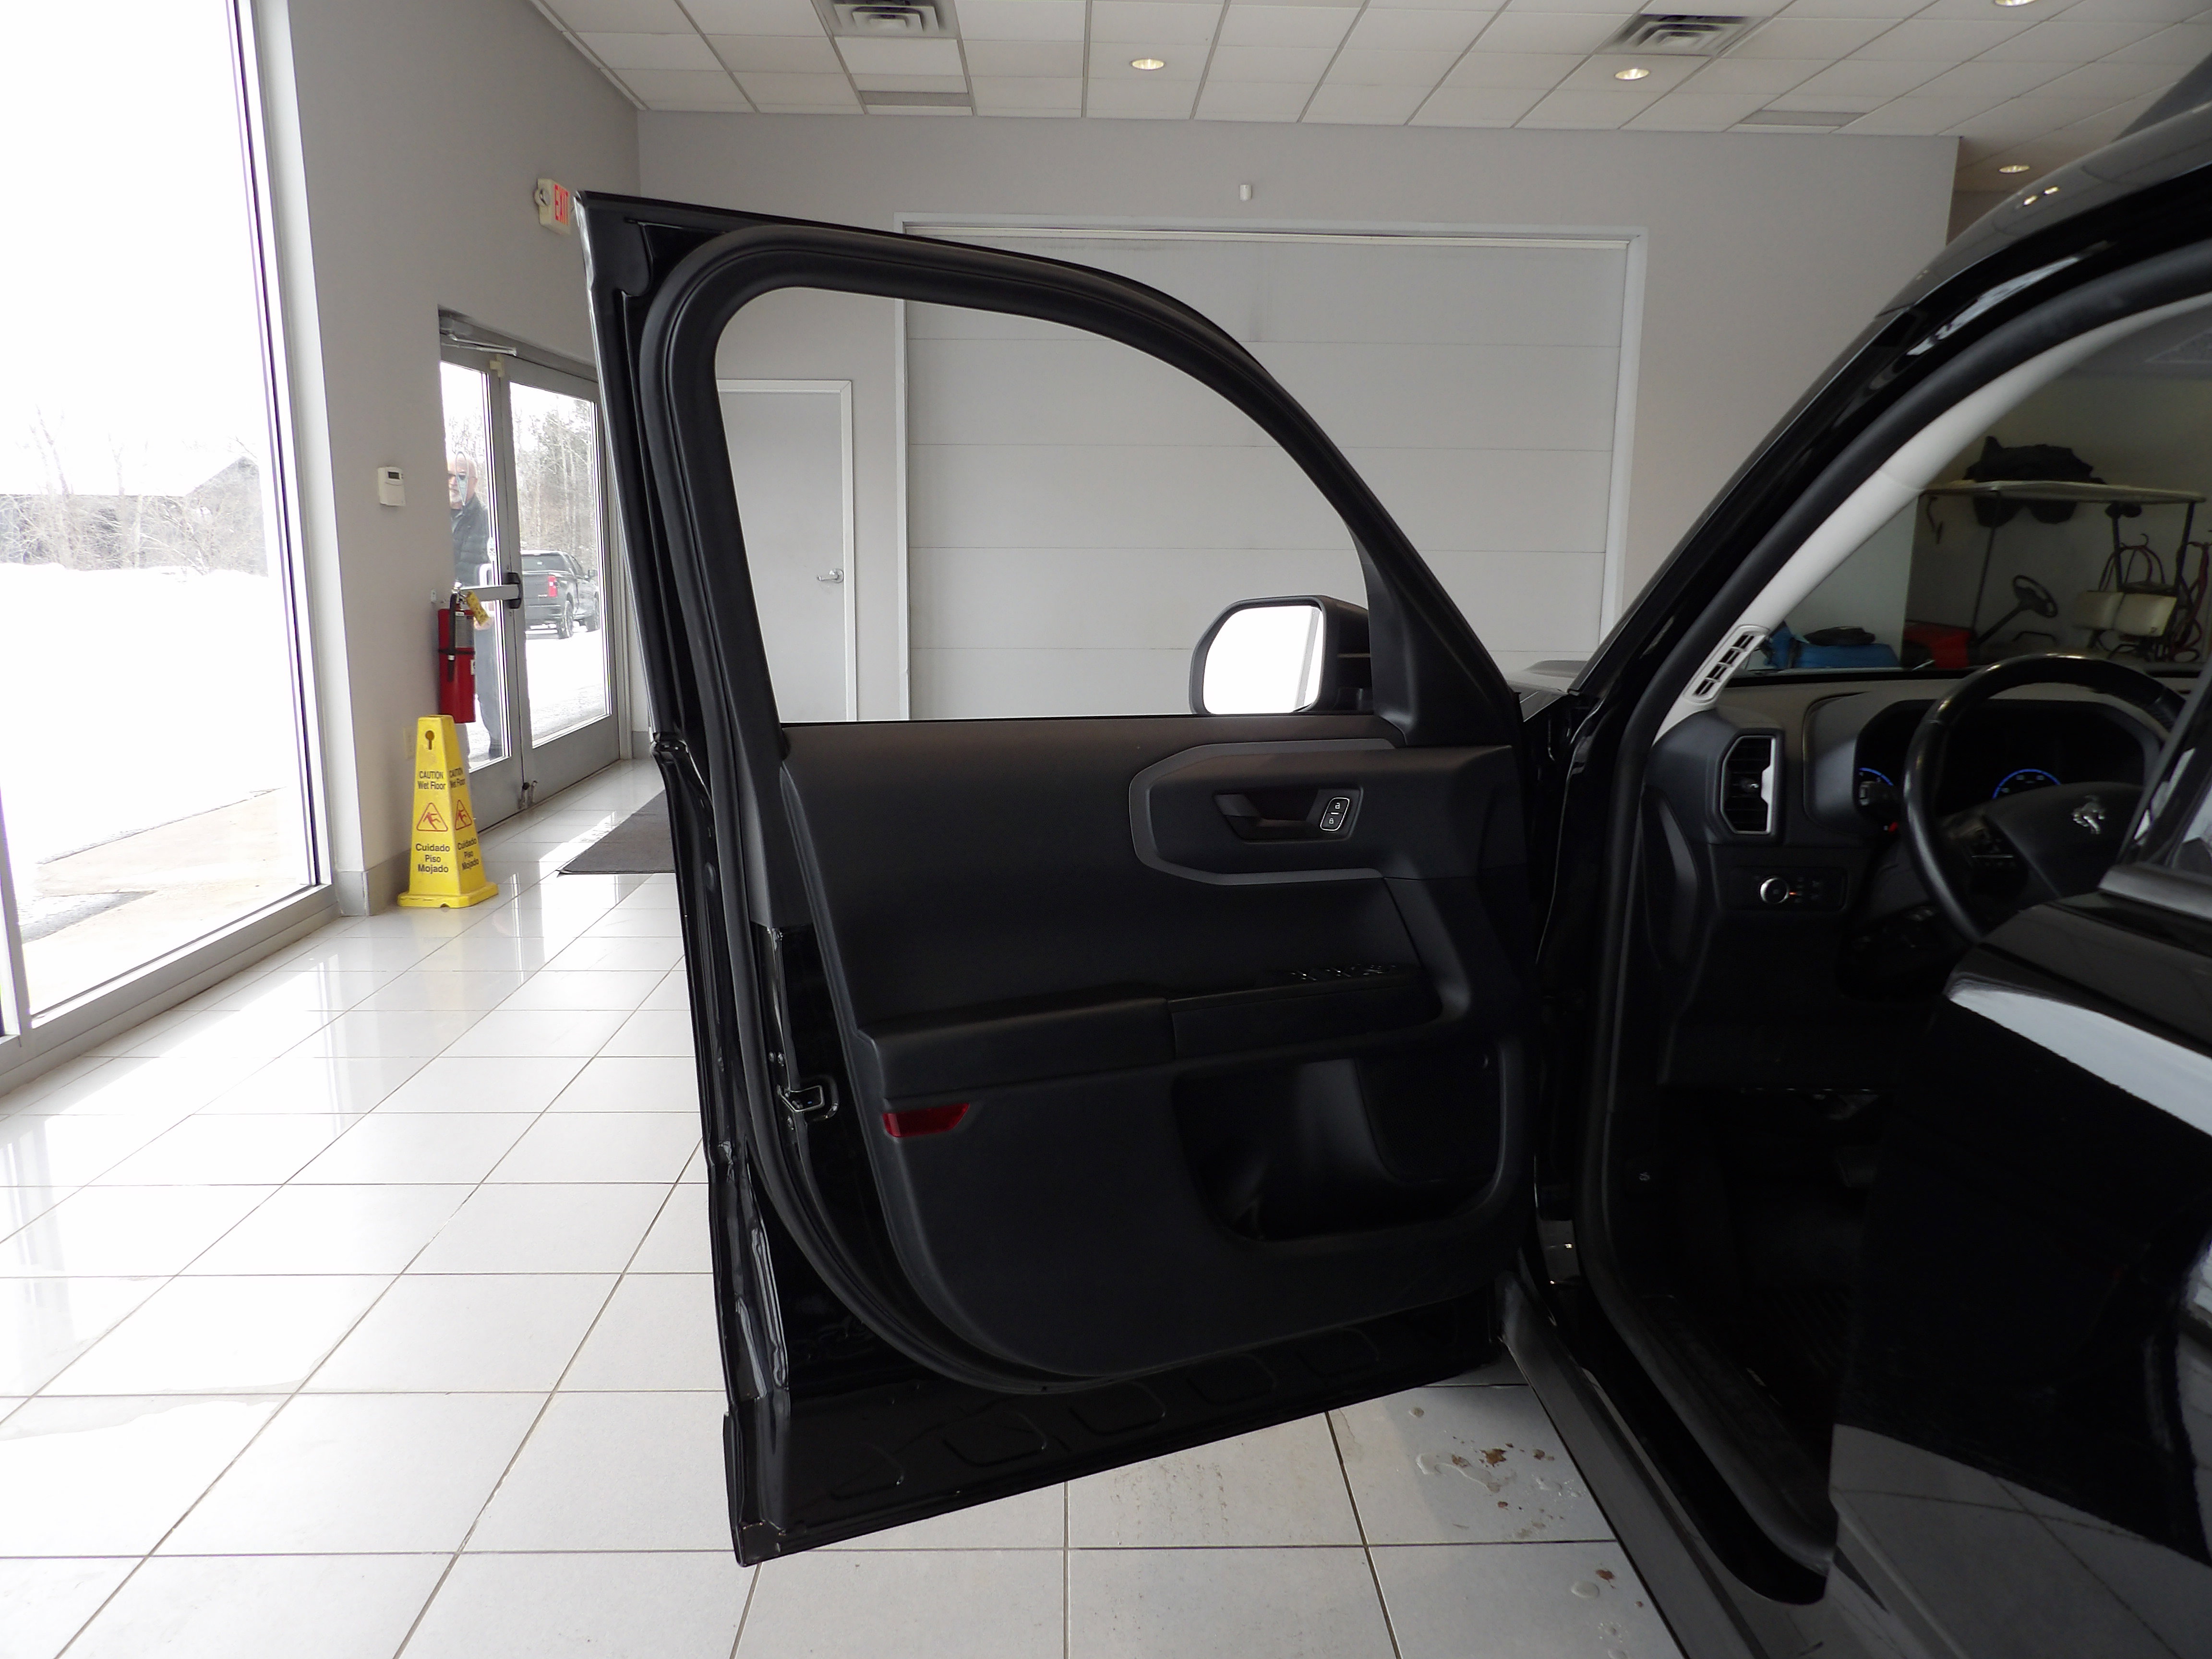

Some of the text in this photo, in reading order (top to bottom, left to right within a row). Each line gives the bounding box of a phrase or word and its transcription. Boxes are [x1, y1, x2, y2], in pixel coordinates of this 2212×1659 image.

[554, 184, 568, 226] EXIT
[418, 781, 446, 789] Wet Floor
[416, 843, 450, 852] Cuidado
[457, 838, 477, 850] Cuidado
[425, 854, 441, 863] Piso
[464, 851, 473, 859] Piso
[462, 858, 479, 870] Mojado
[418, 864, 449, 874] Mojado
